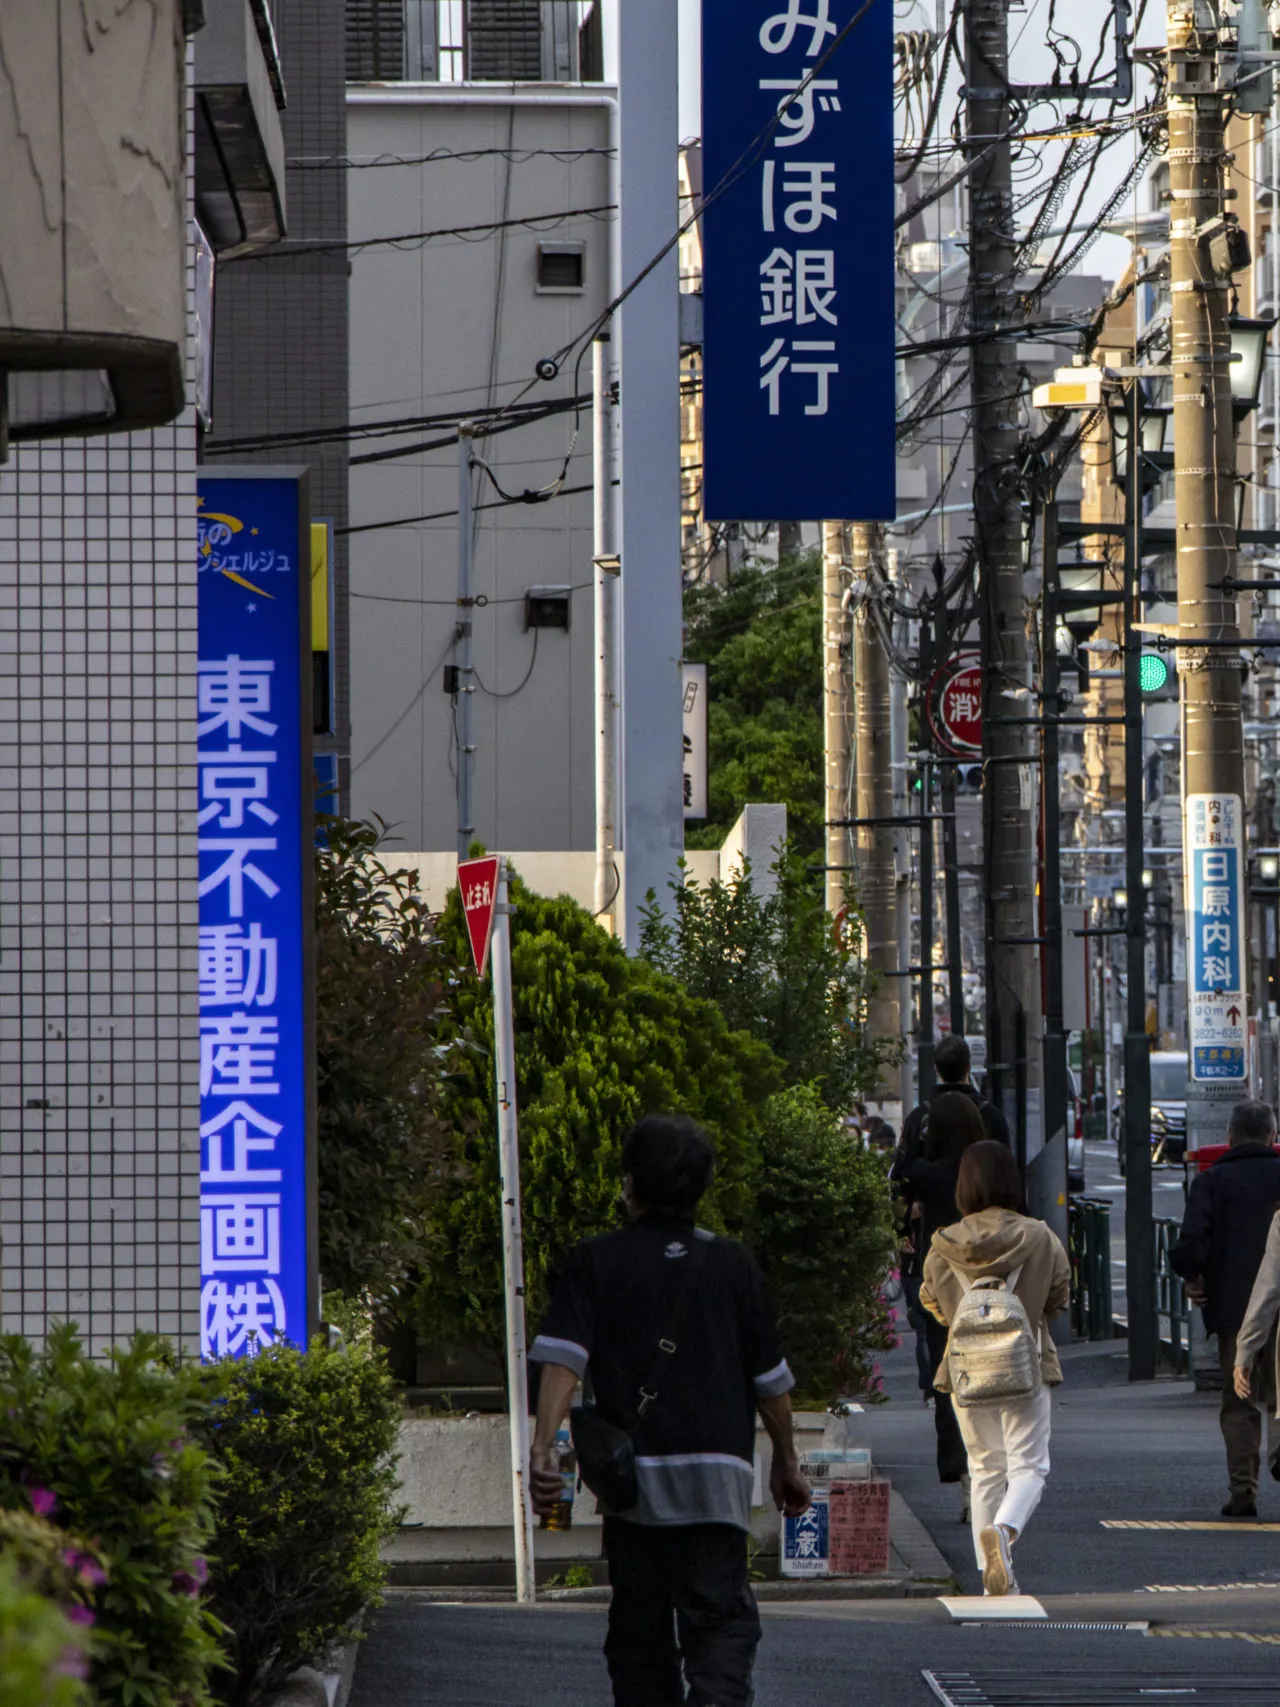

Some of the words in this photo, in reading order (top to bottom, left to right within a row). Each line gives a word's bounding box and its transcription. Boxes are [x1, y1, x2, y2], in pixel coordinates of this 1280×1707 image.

[758, 0, 840, 417] みずほ銀行
[955, 678, 970, 687] FIRE
[466, 881, 491, 911] 止まれ
[1201, 852, 1232, 988] 日原内科
[1195, 1006, 1223, 1017] 90m
